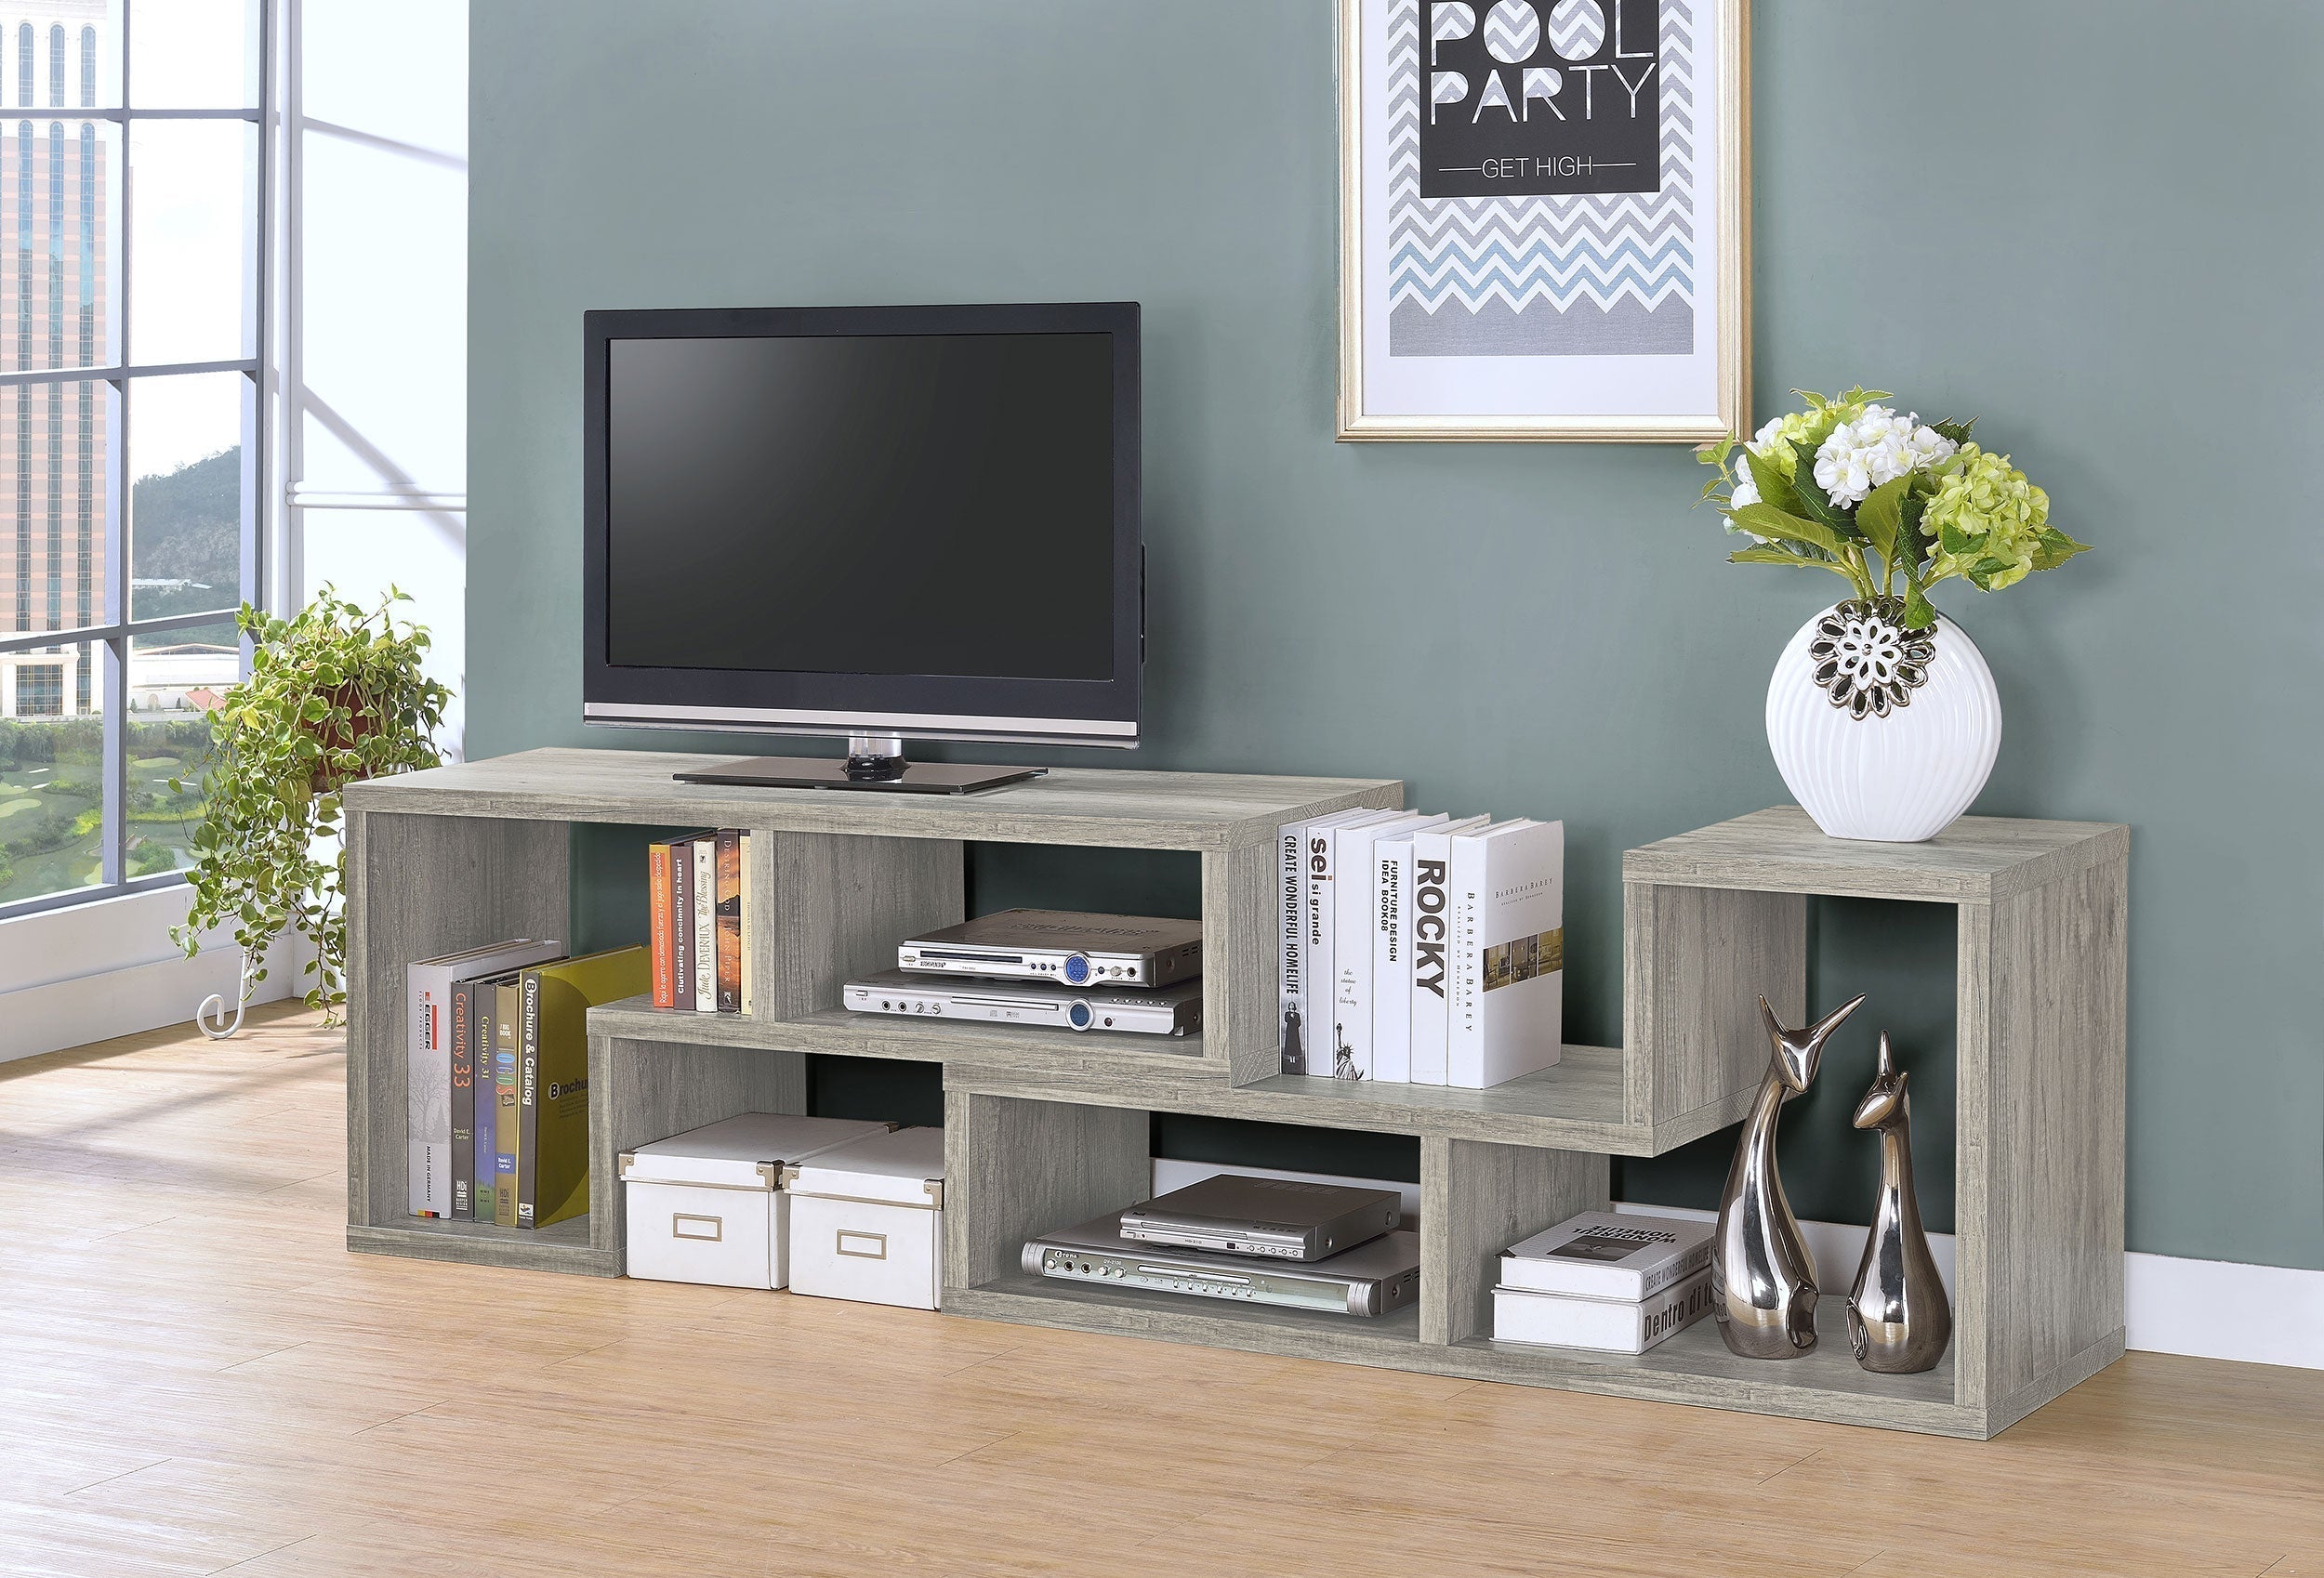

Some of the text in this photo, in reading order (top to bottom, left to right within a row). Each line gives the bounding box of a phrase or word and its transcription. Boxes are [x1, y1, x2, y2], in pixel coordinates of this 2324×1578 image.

[1431, 0, 1654, 66] POOL
[1430, 62, 1657, 125] PARTY
[1481, 155, 1592, 178] GET HIGH
[1285, 835, 1299, 994] CREATE WONDERFUL HOMELIFE
[1390, 861, 1398, 920] FURNITURE
[1495, 877, 1553, 899] BARBERA BAREY
[696, 871, 712, 1000] Jude DEVERAUX The Blessing
[1310, 899, 1321, 945] grande
[1417, 860, 1446, 998] ROCKY
[1345, 986, 1351, 994] of
[1465, 892, 1474, 1032] BARBERA BAREY
[1339, 997, 1356, 1006] liberty
[454, 993, 470, 1087] Creativity 33
[480, 1016, 490, 1079] Creativity 31
[522, 979, 536, 1106] Brochure & Catalog
[1572, 1229, 1676, 1243] WONDERFUL
[1592, 1225, 1676, 1238] HOMELIFE
[1645, 1270, 1661, 1291] CREATE
[1644, 1299, 1684, 1342] Dentro
[1689, 1285, 1701, 1315] di
